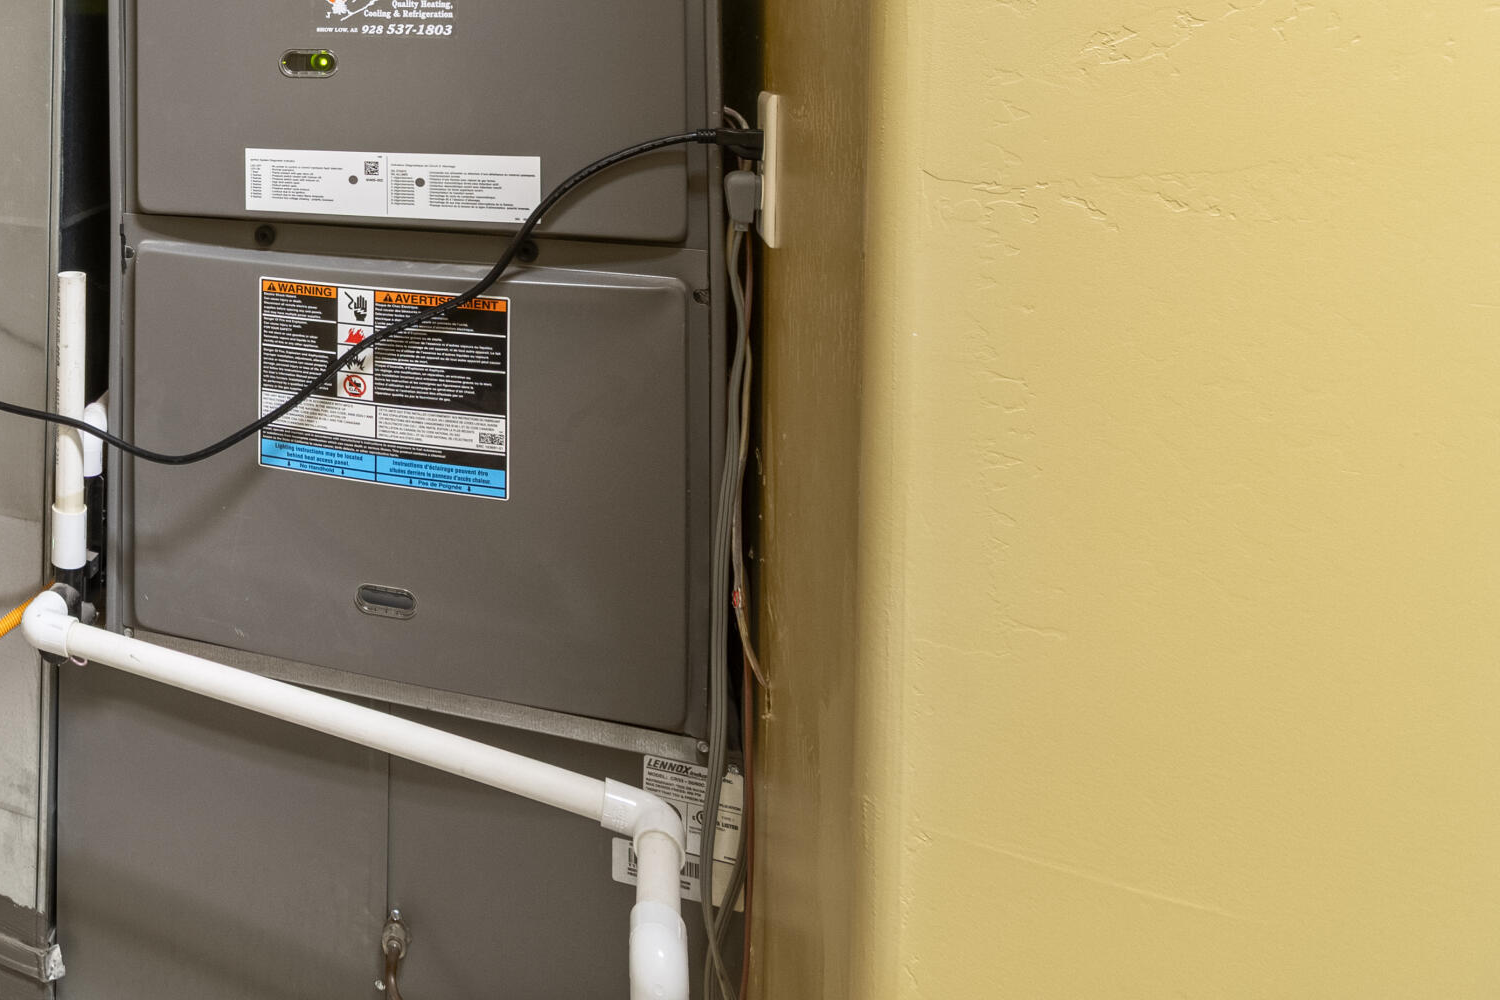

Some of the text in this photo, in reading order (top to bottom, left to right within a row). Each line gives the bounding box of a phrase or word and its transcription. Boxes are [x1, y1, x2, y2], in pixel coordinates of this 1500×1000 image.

[391, 0, 453, 10] Quality Heating,
[363, 9, 453, 19] Cooling & Refrigeration
[361, 24, 384, 35] 928
[386, 24, 453, 36] 537-1803
[278, 282, 332, 297] WARNING
[275, 442, 295, 451] Lighting
[295, 445, 324, 455] instructions
[325, 449, 336, 457] may
[344, 452, 363, 461] located
[287, 452, 303, 460] behind
[309, 464, 335, 473] Handhold
[392, 460, 423, 469] Instructions
[646, 758, 693, 775] LENNOX
